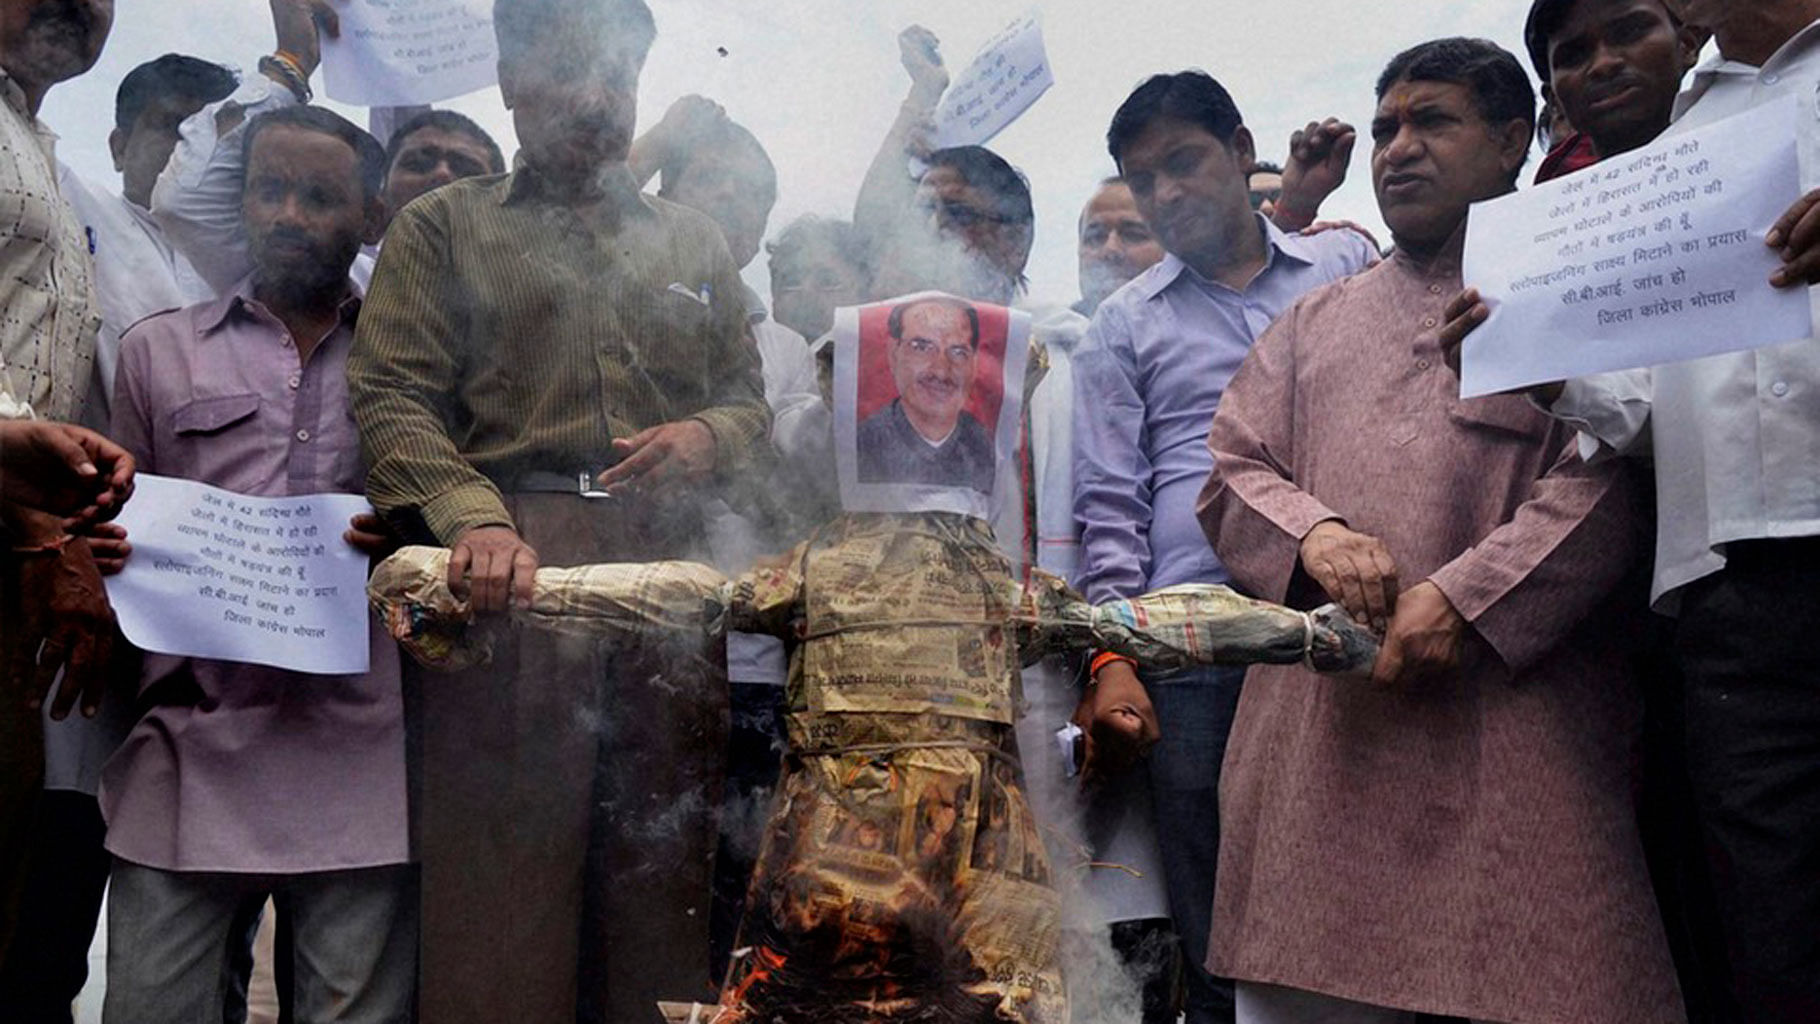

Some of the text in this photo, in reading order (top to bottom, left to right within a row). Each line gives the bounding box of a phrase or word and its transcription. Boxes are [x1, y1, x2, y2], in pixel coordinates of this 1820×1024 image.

[1604, 169, 1621, 180] 42
[1687, 159, 1709, 176] रही
[1704, 180, 1722, 194] की
[1654, 216, 1672, 232] की
[1633, 243, 1672, 264] मिटाने
[1681, 238, 1700, 252] का
[1707, 228, 1748, 248] प्रयास
[1633, 273, 1663, 290] जांच
[1671, 266, 1686, 285] हो
[1597, 288, 1737, 325] जिला कांग्रेस भोपाल
